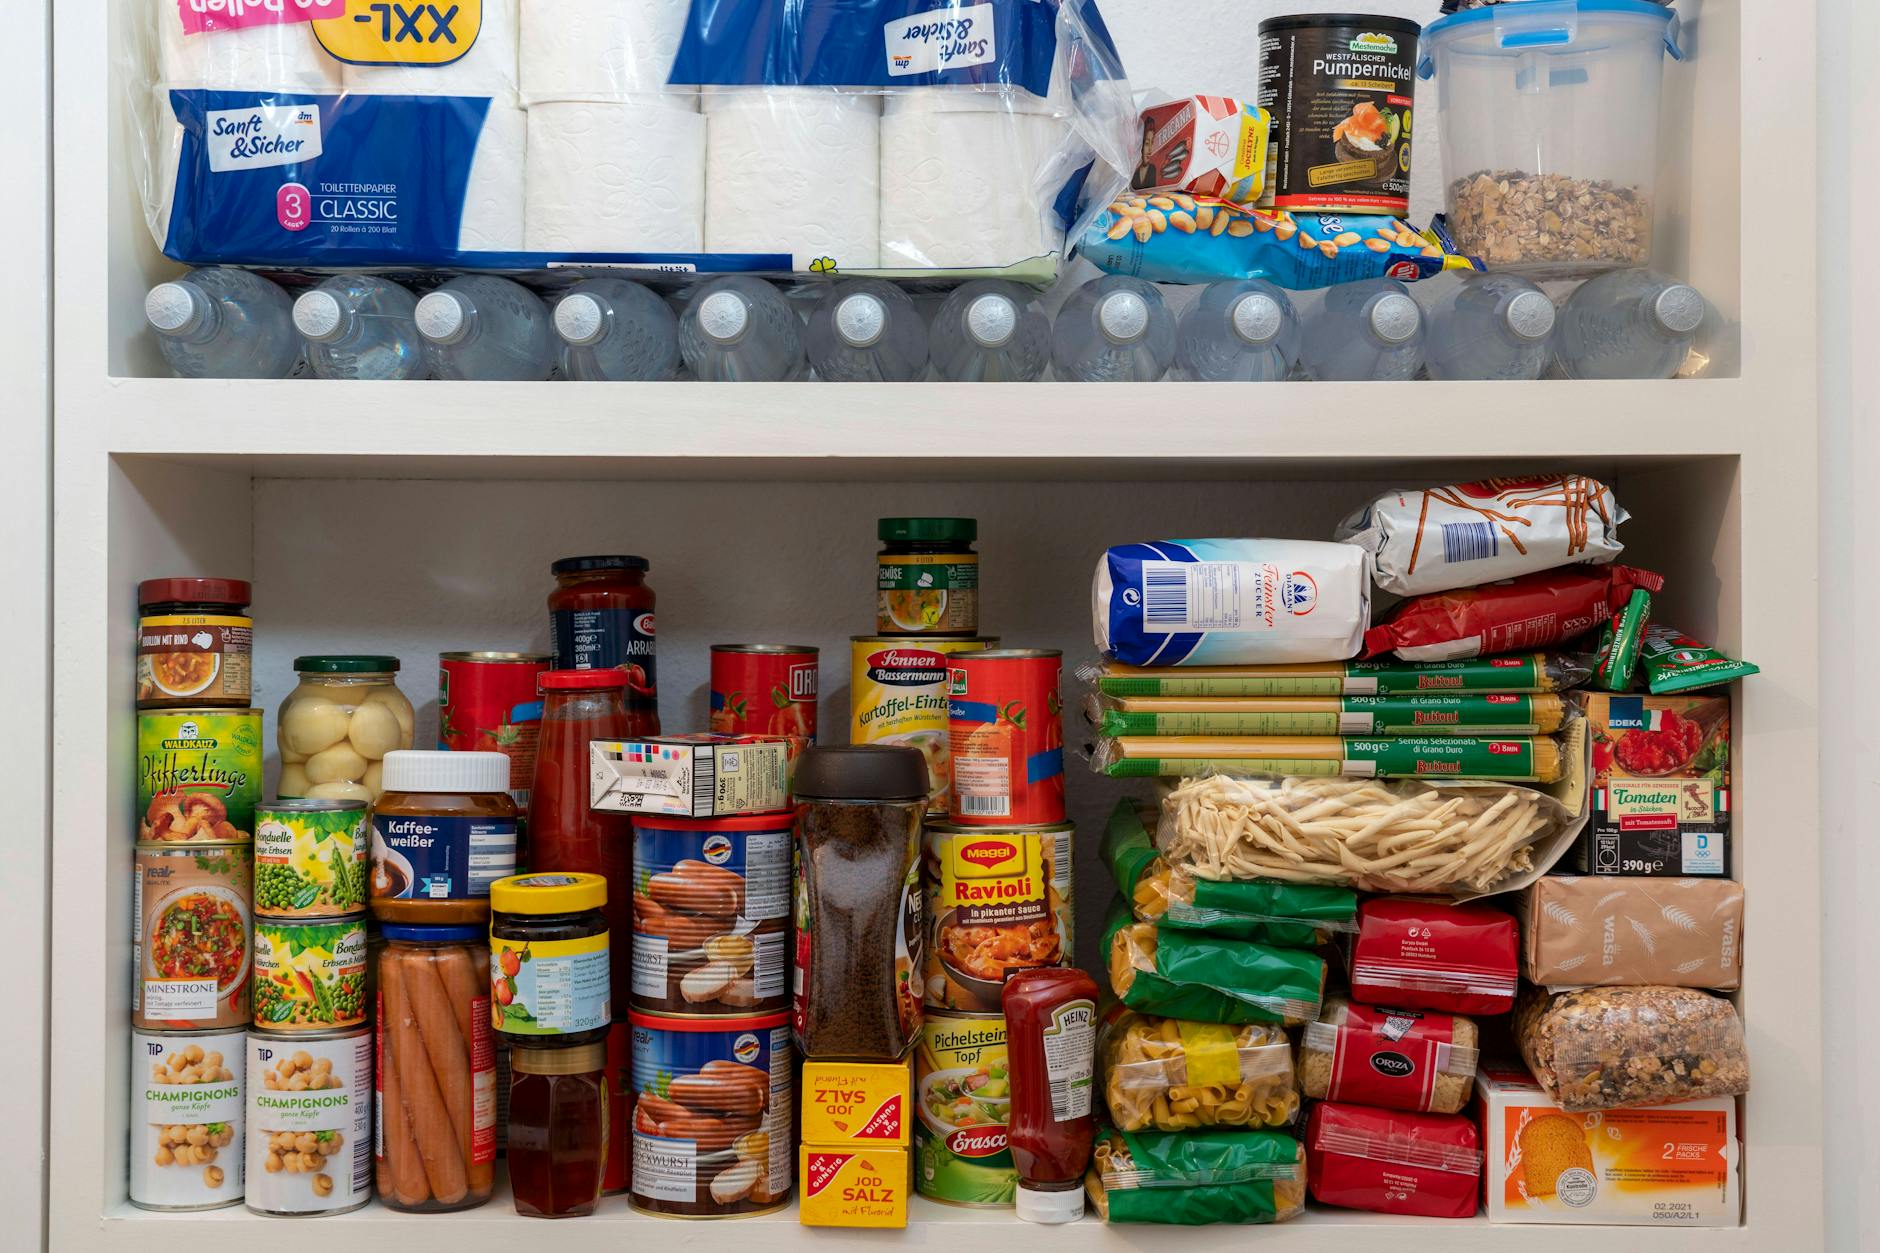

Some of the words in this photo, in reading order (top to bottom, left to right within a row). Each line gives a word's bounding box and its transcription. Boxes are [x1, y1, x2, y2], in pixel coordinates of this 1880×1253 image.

[354, 4, 458, 44] XXL-
[1352, 42, 1396, 53] Mestemacher
[1326, 53, 1386, 63] WESTFÄLISCHER
[1313, 59, 1411, 81] Pumpernickel
[297, 112, 312, 121] dm
[213, 115, 261, 138] Sanft
[1158, 108, 1191, 145] TRICANA
[1245, 126, 1254, 169] JOCELYNE
[320, 182, 396, 193] TOILETTENPAPIER
[286, 193, 301, 218] 3
[320, 200, 397, 219] CLASSIC
[162, 635, 172, 646] MIT
[881, 651, 936, 666] Sonnen
[875, 669, 944, 681] Bassermann
[1418, 675, 1463, 688] Buitoni
[1415, 711, 1459, 724] Buitoni
[165, 740, 214, 749] WALDKAUZ
[1398, 737, 1428, 745] Semola
[1430, 737, 1476, 745] Selezionata
[1416, 760, 1461, 773] Buitoni
[142, 752, 246, 798] Pfifferlinge
[718, 777, 726, 795] 390
[1613, 789, 1677, 805] Tomaten
[388, 821, 438, 834] Kaffee-
[390, 835, 434, 847] weißer
[269, 846, 292, 854] Erbsen
[956, 878, 1031, 900] Ravioli
[981, 907, 1016, 919] pikanter
[1017, 904, 1040, 914] Sauce
[1603, 915, 1616, 966] wasa
[1721, 918, 1734, 969] wasa
[322, 959, 347, 968] Erbsen
[147, 984, 214, 993] MINESTRONE
[1063, 1010, 1088, 1027] HEINZ
[147, 1043, 163, 1056] TiP
[258, 1049, 273, 1061] TiP
[955, 1048, 981, 1064] Topf
[1375, 1058, 1409, 1070] ORYZA
[146, 1087, 239, 1102] CHAMPIGNONS
[815, 1089, 865, 1103] SALZ
[191, 1103, 210, 1112] Köpfe
[257, 1095, 348, 1109] CHAMPIGNONS
[301, 1111, 319, 1119] Köpfe
[826, 1105, 854, 1115] JOD
[866, 1104, 896, 1135] GÜNSTIG
[884, 1120, 898, 1136] GUT
[1662, 1142, 1674, 1159] 2
[811, 1156, 825, 1172] GUT
[812, 1158, 842, 1188] GÜNSTIG
[855, 1177, 882, 1187] JOD
[843, 1188, 893, 1203] SALZ
